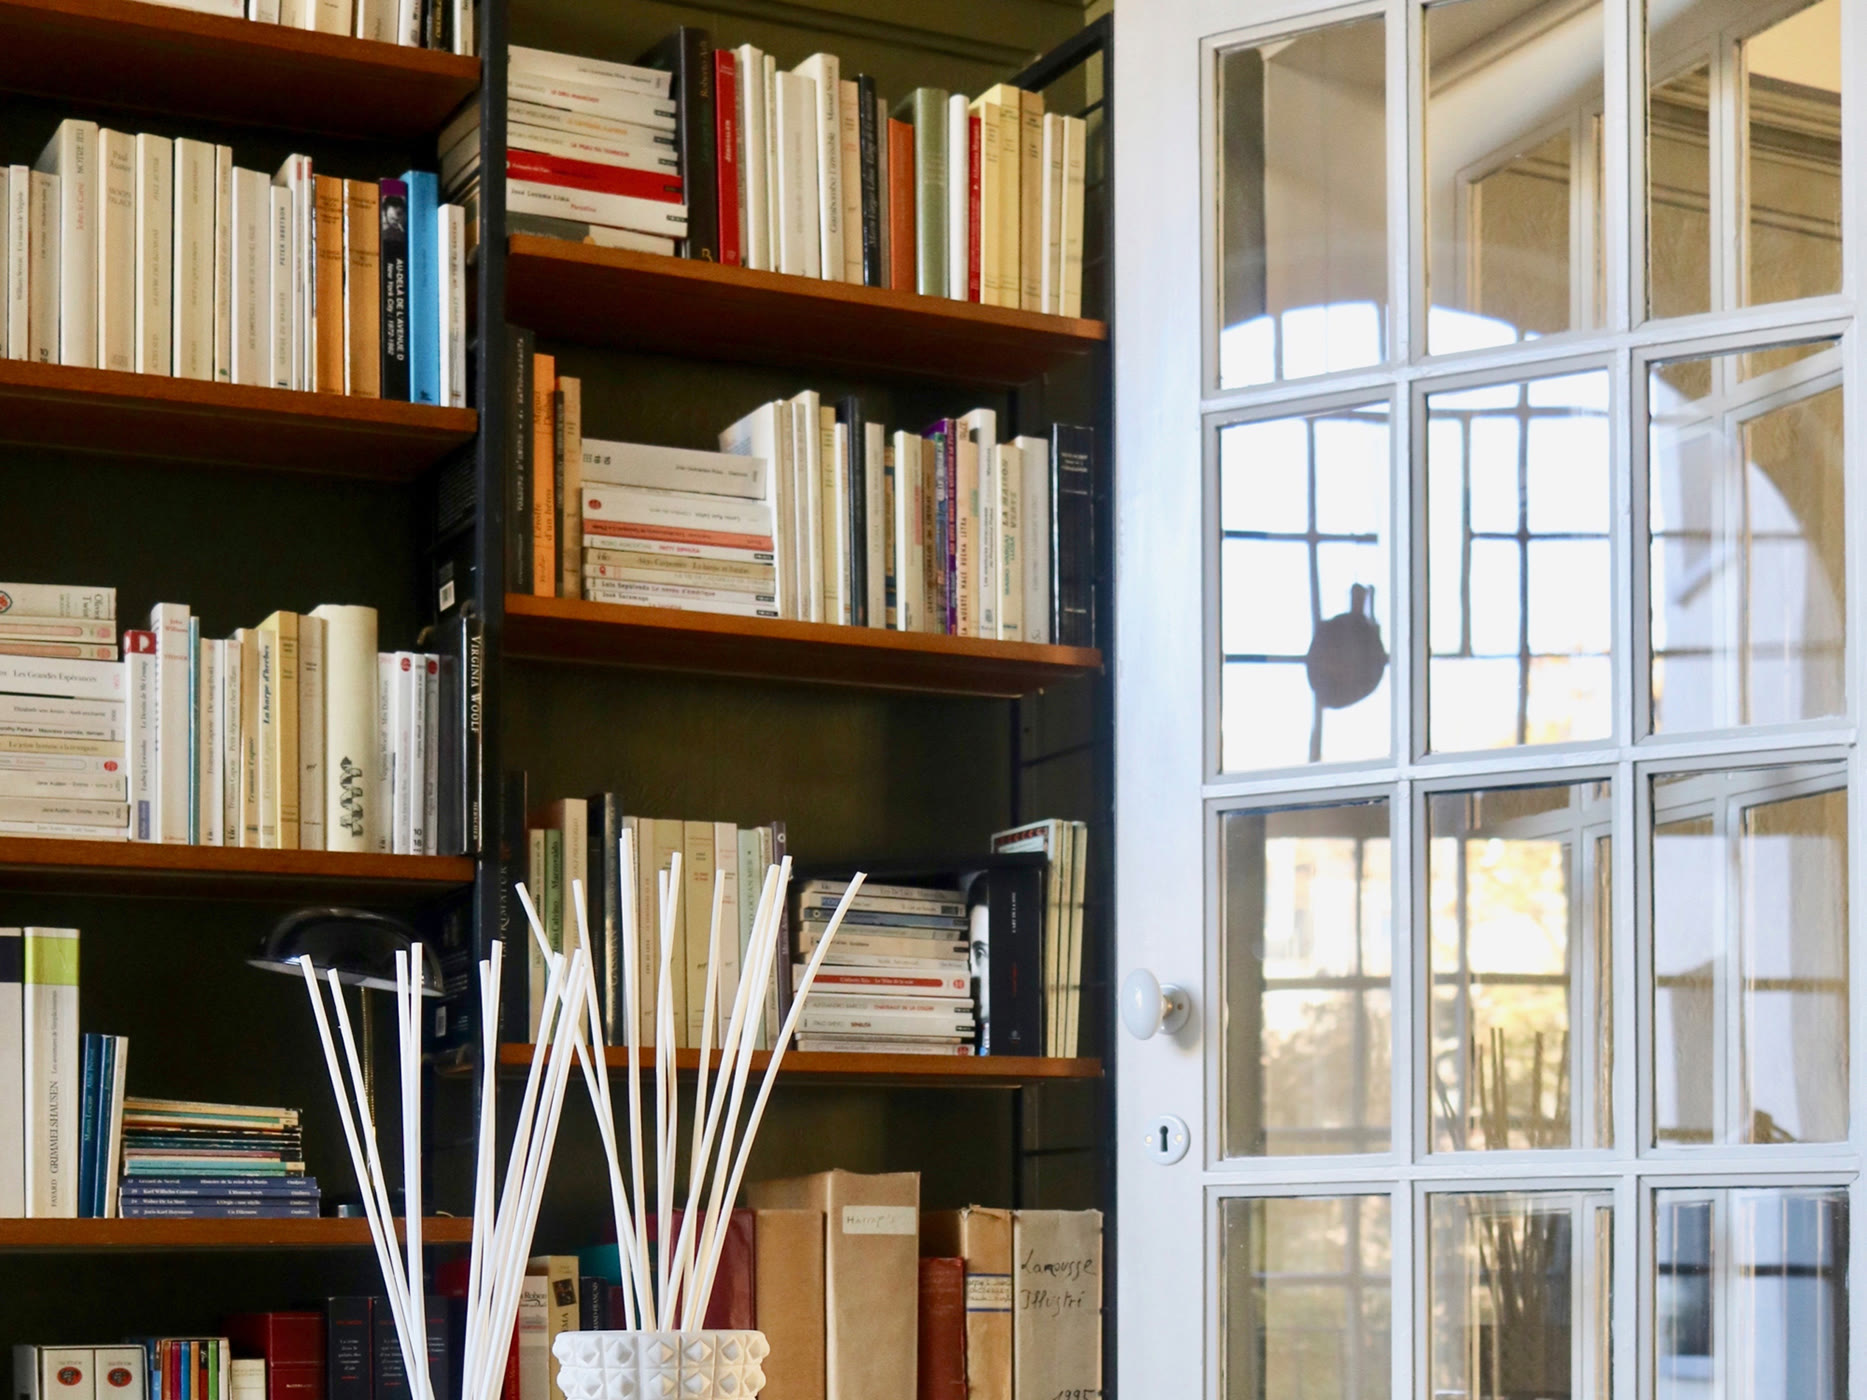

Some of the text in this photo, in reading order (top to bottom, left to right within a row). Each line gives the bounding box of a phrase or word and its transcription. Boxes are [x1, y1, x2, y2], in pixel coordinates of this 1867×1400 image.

[471, 635, 481, 734] VIRGINIA WOOLF
[551, 901, 560, 932] Calvino
[50, 1081, 59, 1174] GRIMMELSHAUSEN
[1021, 1248, 1097, 1282] Larousse
